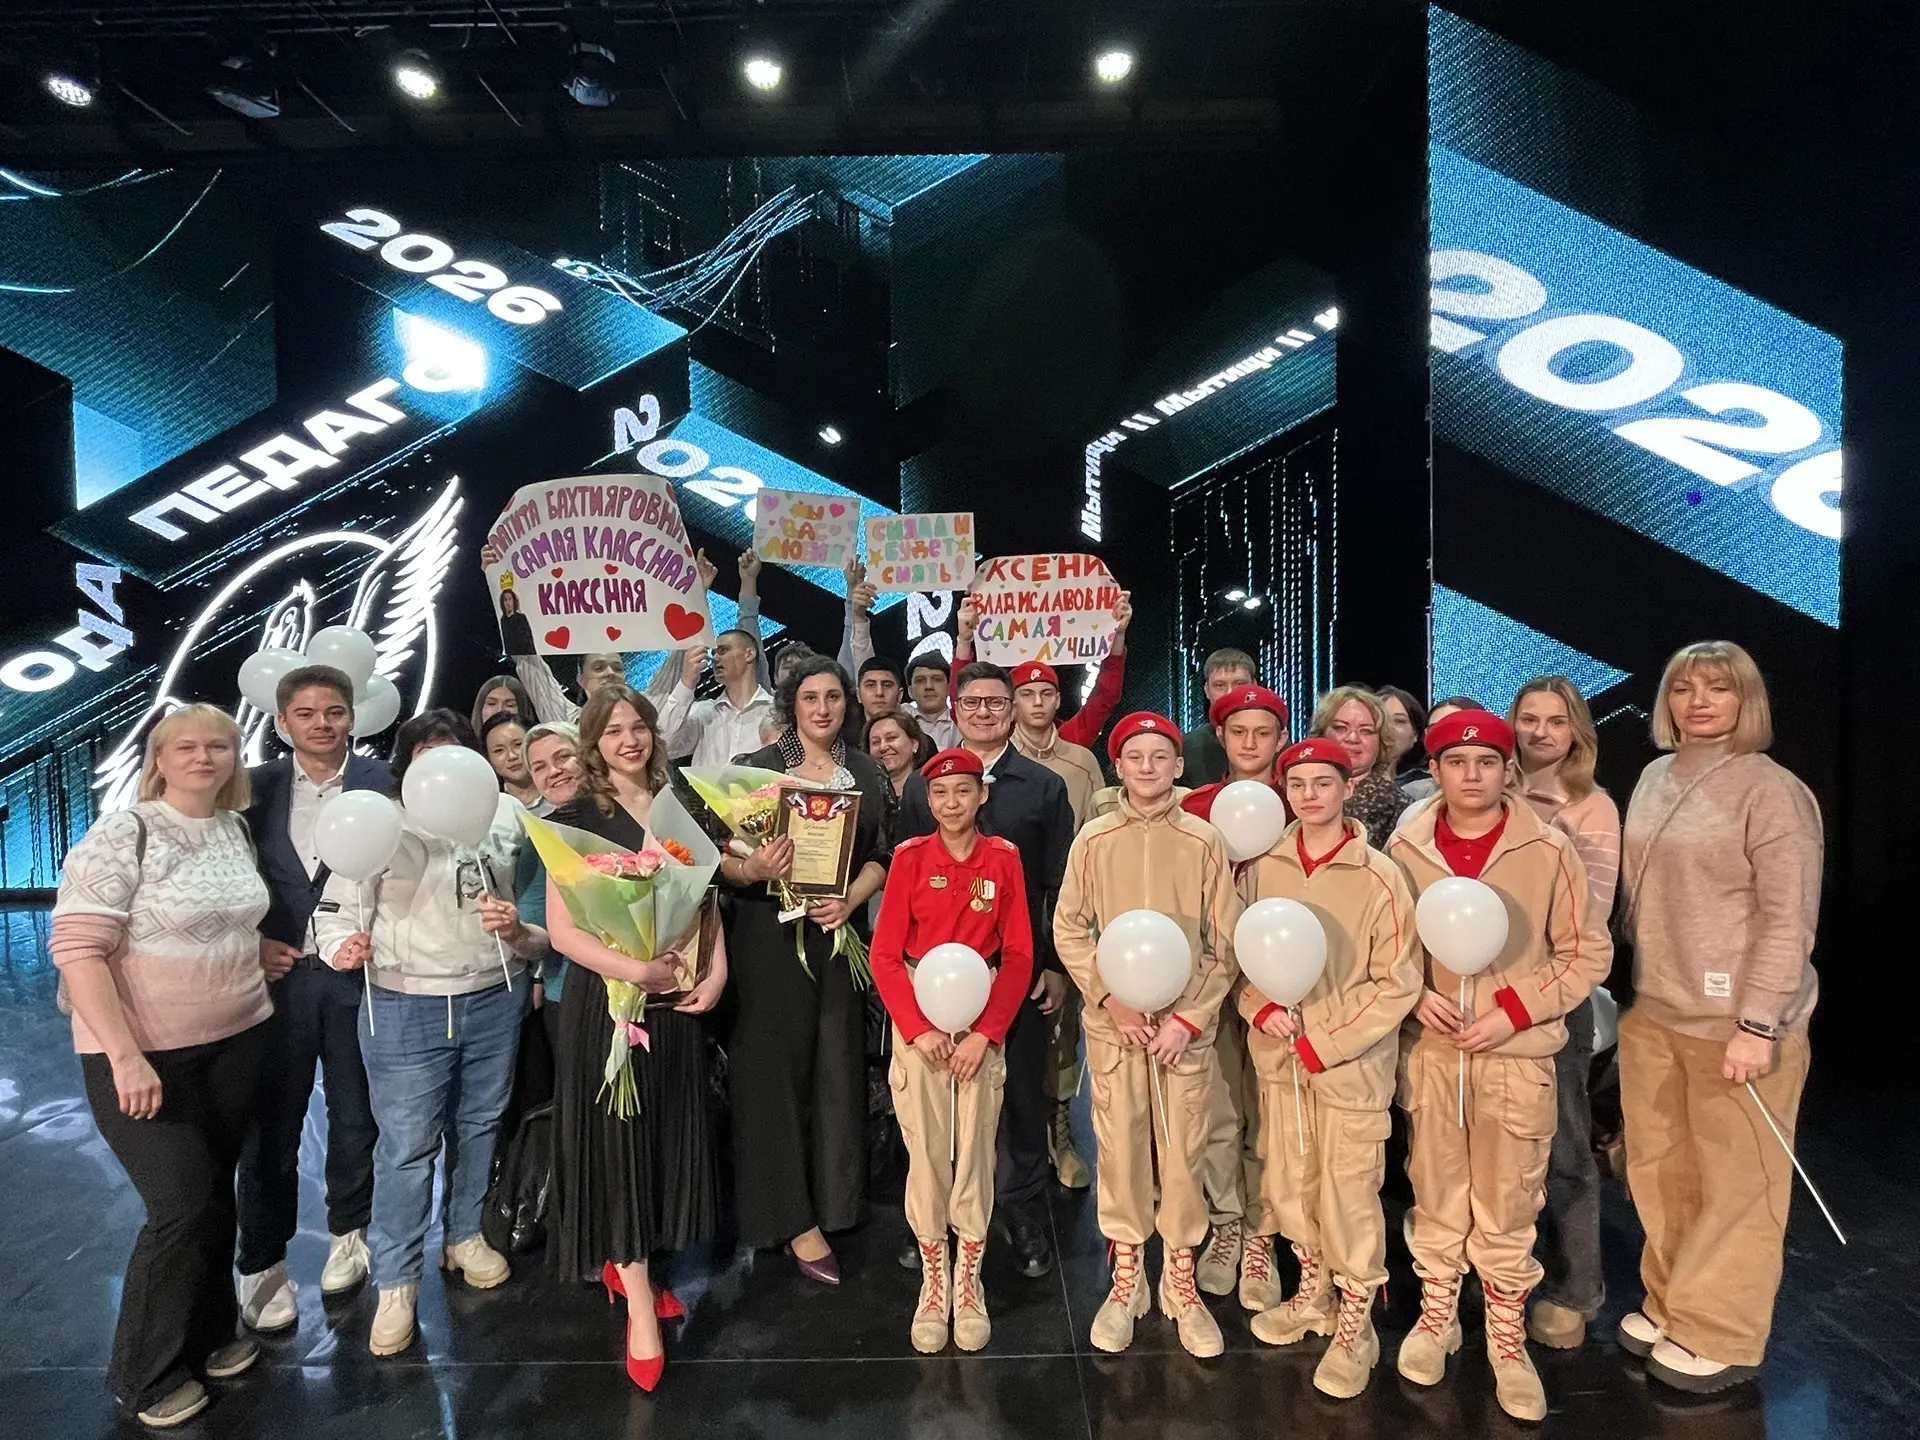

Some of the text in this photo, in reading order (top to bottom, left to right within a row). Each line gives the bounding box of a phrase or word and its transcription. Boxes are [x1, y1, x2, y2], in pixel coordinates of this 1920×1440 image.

[320, 208, 563, 325] 2026
[1154, 347, 1282, 417] Мытищи
[128, 310, 486, 541] ПЕДАГО
[614, 393, 764, 522] 202
[511, 526, 698, 595] САМАЯ КЛАССНАЯ
[986, 555, 1108, 582] КСЕНИ
[538, 577, 648, 616] КЛАССНАЯ
[978, 615, 1062, 641] САМАЯ
